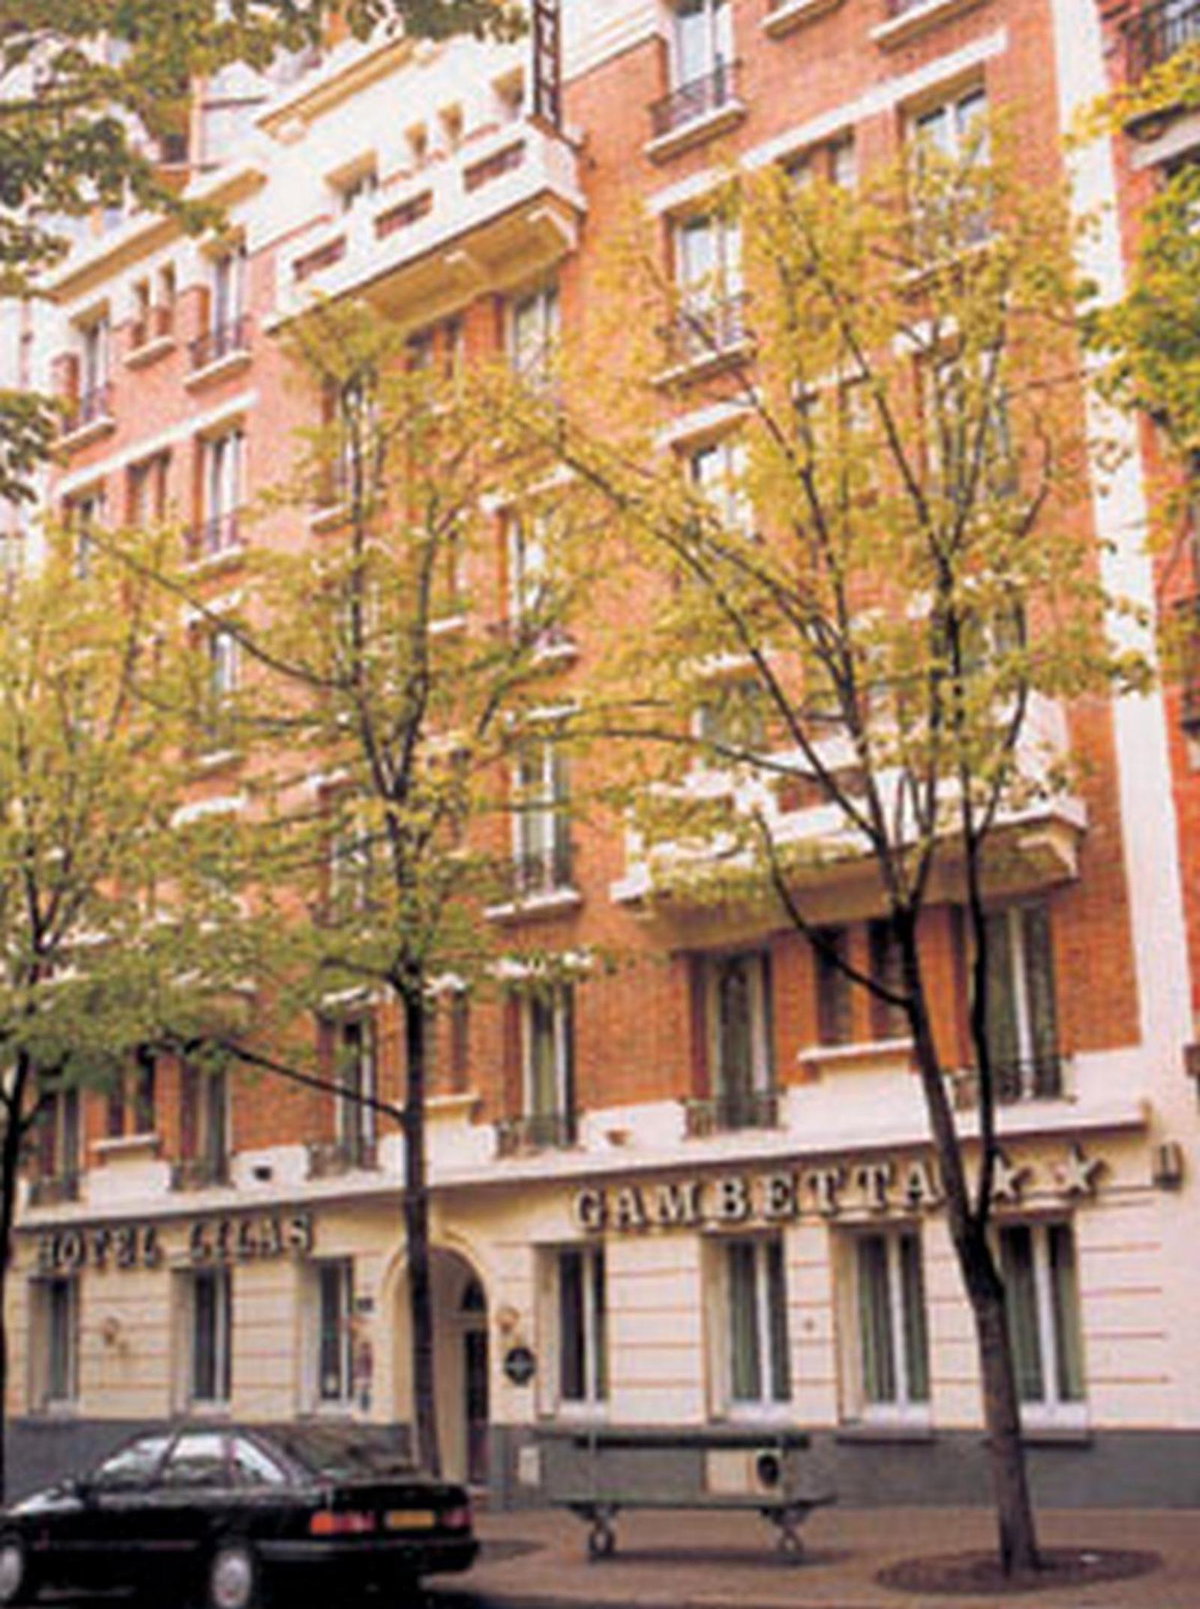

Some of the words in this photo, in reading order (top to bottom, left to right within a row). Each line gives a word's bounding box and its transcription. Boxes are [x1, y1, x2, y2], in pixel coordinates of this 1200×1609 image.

[38, 1228, 162, 1272] HOTEL
[190, 1213, 312, 1260] LILAS
[574, 1161, 945, 1232] GAMBETTA
